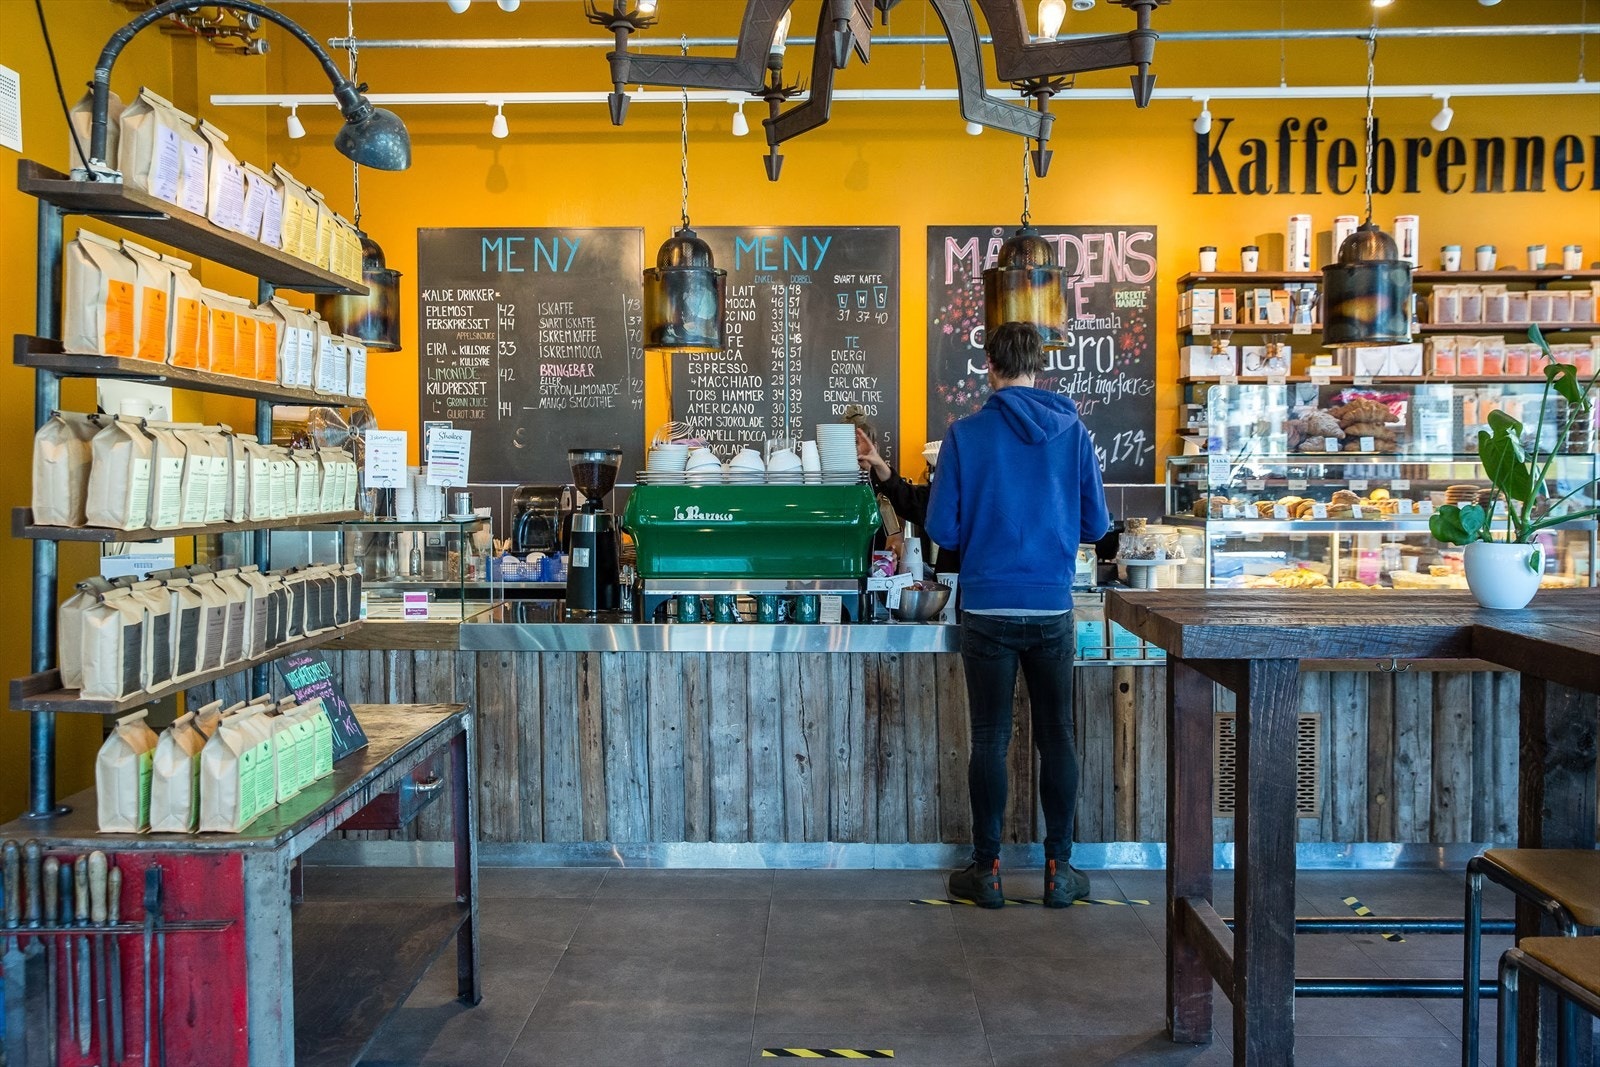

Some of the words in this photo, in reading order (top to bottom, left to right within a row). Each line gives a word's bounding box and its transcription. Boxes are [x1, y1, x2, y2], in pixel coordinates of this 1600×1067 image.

[481, 237, 580, 272] MENY
[735, 236, 832, 271] MENY
[834, 274, 856, 284] SVART
[860, 274, 882, 284] KAFFE
[424, 290, 454, 301] KALDE
[458, 289, 494, 301] DRIKKER
[732, 286, 756, 296] LAIT
[772, 284, 784, 296] 43
[788, 284, 802, 296] 48
[771, 298, 784, 308] 46
[788, 296, 800, 307] 51
[878, 293, 884, 304] S
[426, 306, 474, 316] EPLEMOST
[500, 304, 515, 316] 42
[538, 302, 574, 315] ISKAFFE
[772, 308, 784, 320] 39
[788, 308, 800, 320] 44
[566, 317, 596, 328] ISKAFFE
[628, 316, 642, 326] 37
[836, 310, 850, 322] 31
[856, 311, 870, 322] 37
[875, 312, 888, 324] 40
[426, 319, 490, 330] FERSKPRESSET
[500, 318, 514, 330] 44
[772, 322, 784, 332] 39
[788, 322, 800, 332] 44
[629, 329, 642, 342] 70
[771, 334, 784, 345] 43
[844, 336, 859, 348] TE
[426, 342, 448, 356] EIRA
[460, 346, 490, 356] KULLSYRE
[500, 342, 516, 356] 33
[772, 346, 784, 358] 46
[790, 346, 802, 358] 51
[831, 350, 866, 360] ENERGI
[460, 358, 490, 366] KULLSYRE
[688, 362, 748, 374] ESPRESSO
[772, 360, 784, 372] 24
[790, 360, 802, 372] 29
[428, 367, 480, 380] LIMONADE
[500, 368, 516, 382] 42
[540, 364, 595, 378] BRINGEBÆR
[831, 364, 864, 374] GRØNN
[540, 376, 562, 386] ELLER
[698, 376, 762, 388] MACCHIATO
[771, 374, 784, 386] 29
[790, 374, 802, 386] 34
[829, 377, 850, 388] EARL
[852, 377, 878, 388] GREY
[426, 382, 487, 394] KALDPRESSET
[540, 384, 572, 396] SITRON
[574, 384, 621, 396] LIMONADE
[688, 390, 716, 400] TORS
[722, 390, 764, 401] HAMMER
[772, 389, 784, 400] 34
[790, 388, 802, 401] 39
[824, 390, 858, 402] BENGAL
[862, 391, 884, 402] FIRE
[499, 402, 512, 416] 44
[539, 397, 566, 410] MANGO
[570, 396, 616, 408] SMOOTHIE
[687, 403, 754, 414] AMERICANO
[772, 402, 786, 414] 30
[790, 402, 802, 414] 35
[686, 416, 712, 428] VARM
[716, 416, 764, 428] SJOKOLADE
[790, 416, 802, 428] 45
[688, 430, 735, 442] KARAMELL
[738, 430, 766, 442] MOCCA
[790, 430, 803, 440] 53
